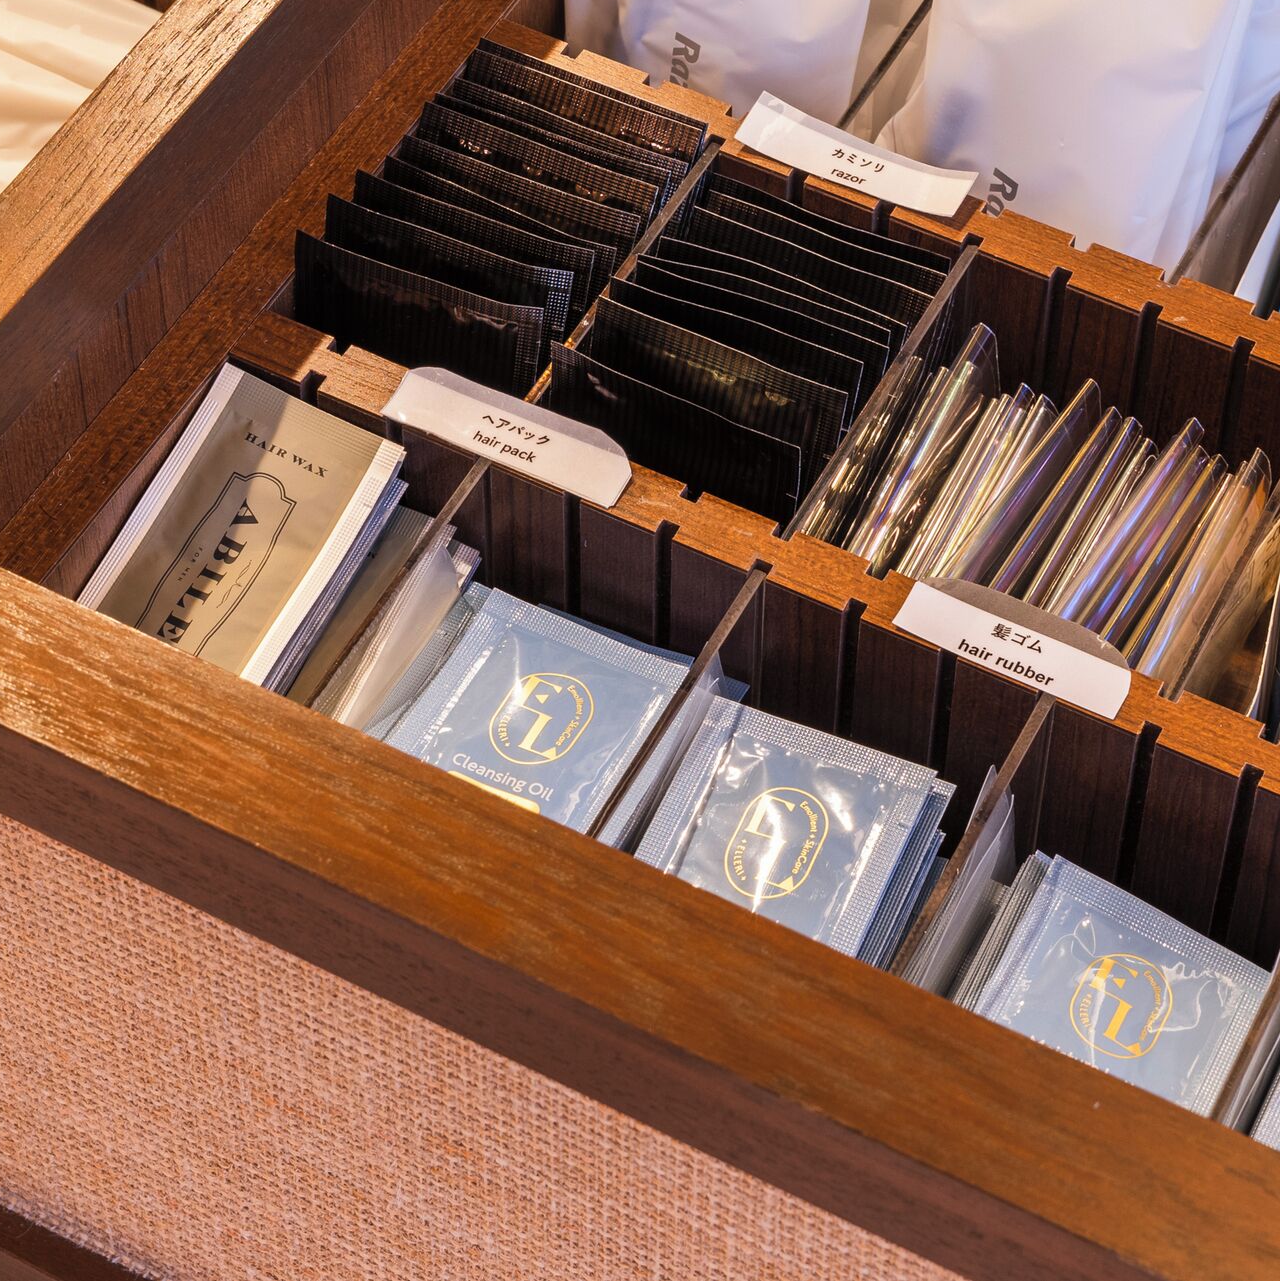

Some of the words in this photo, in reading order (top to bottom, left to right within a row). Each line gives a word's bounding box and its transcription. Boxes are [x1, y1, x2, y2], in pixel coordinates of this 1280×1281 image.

[831, 148, 885, 172] カミソリ
[831, 168, 867, 184] razor
[482, 414, 551, 445] ヘアパック
[244, 431, 288, 458] HAIR
[292, 454, 329, 478] WAX
[473, 430, 501, 448] hair
[499, 444, 537, 463] pack
[156, 497, 260, 645] ABILE
[190, 546, 204, 564] FOR
[990, 623, 1042, 654] 髪ゴム
[957, 638, 993, 661] hair
[995, 656, 1054, 686] rubber
[451, 752, 527, 793] Cleansing
[528, 782, 555, 802] Oil
[800, 800, 818, 833] Emollient
[733, 844, 746, 876] ELLERI
[791, 839, 815, 875] SkinCare
